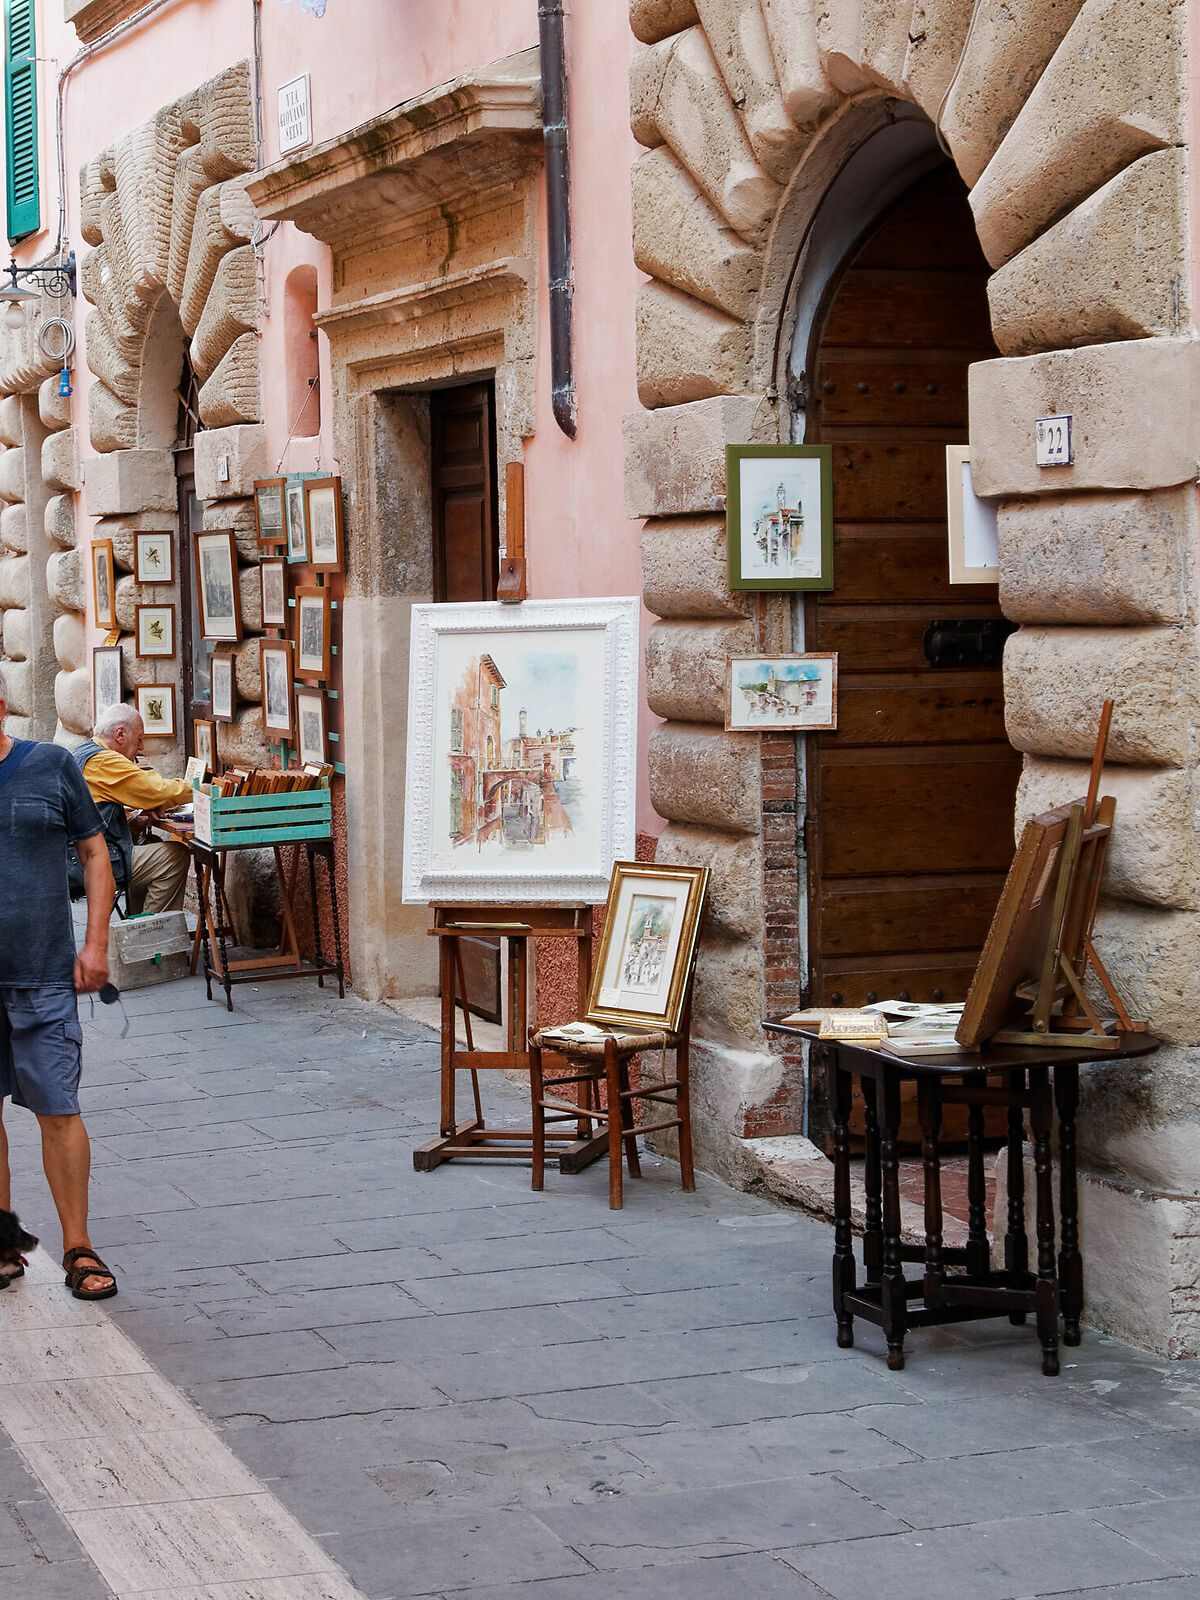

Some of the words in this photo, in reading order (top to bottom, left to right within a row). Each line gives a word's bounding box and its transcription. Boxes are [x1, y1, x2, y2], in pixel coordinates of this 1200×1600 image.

[286, 90, 298, 107] VIA
[280, 102, 305, 127] GIOVANNI
[1048, 427, 1063, 454] 22
